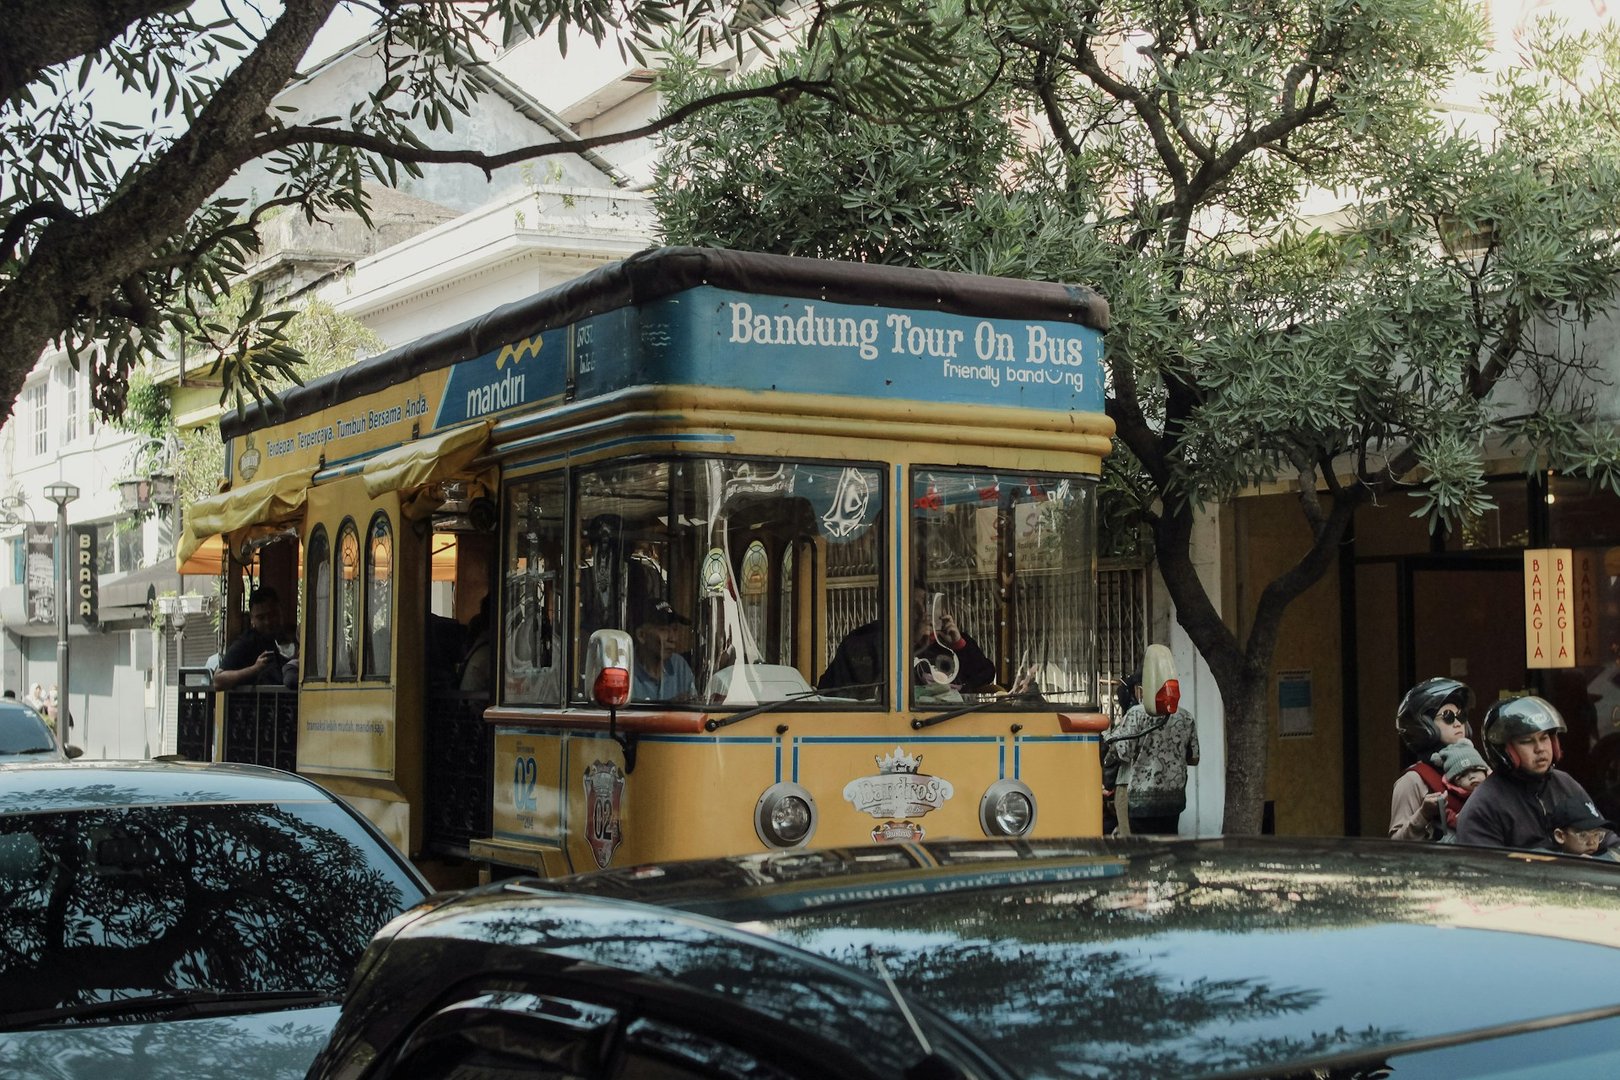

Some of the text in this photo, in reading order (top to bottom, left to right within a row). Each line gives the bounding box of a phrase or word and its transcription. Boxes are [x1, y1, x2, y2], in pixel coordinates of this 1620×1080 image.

[728, 302, 879, 361] Bandung
[886, 313, 964, 358] Tour
[974, 320, 1016, 363] On
[1025, 324, 1084, 367] Bus
[336, 416, 366, 439] Tumbuh
[368, 406, 402, 430] Bersama
[405, 394, 429, 418] Anda.
[466, 367, 526, 418] mandiri
[79, 533, 92, 616] BRAGA
[1532, 559, 1543, 659] BAHAGIA
[1556, 558, 1567, 658] BAHAGIA
[514, 756, 538, 812] 02
[593, 799, 613, 840] 02
